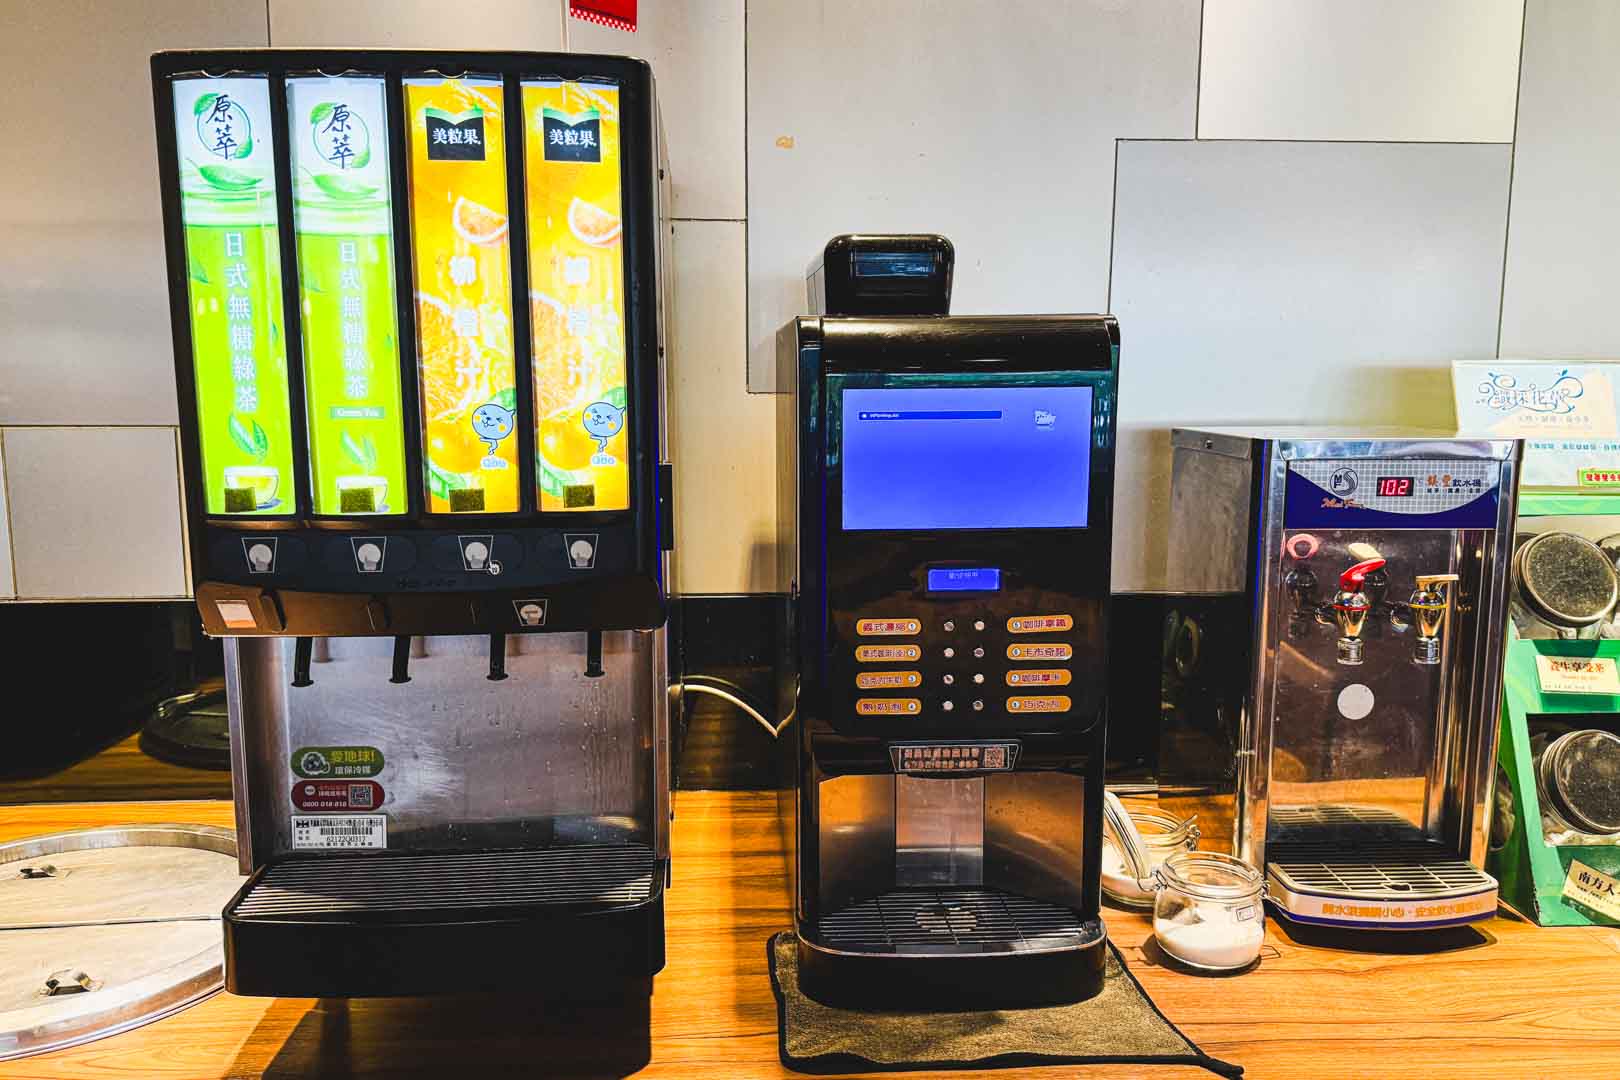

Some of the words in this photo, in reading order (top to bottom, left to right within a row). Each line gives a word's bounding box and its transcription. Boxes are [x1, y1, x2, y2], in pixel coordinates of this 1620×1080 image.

[205, 95, 238, 160] 原萃
[321, 104, 356, 169] 原萃
[432, 127, 480, 146] 美粒果
[549, 127, 597, 147] 美粒果
[224, 232, 258, 412] 日式無糖綠茶
[1378, 479, 1410, 496] 102
[1023, 647, 1066, 657] 卡布奇諾
[1579, 872, 1620, 896] 南方人
